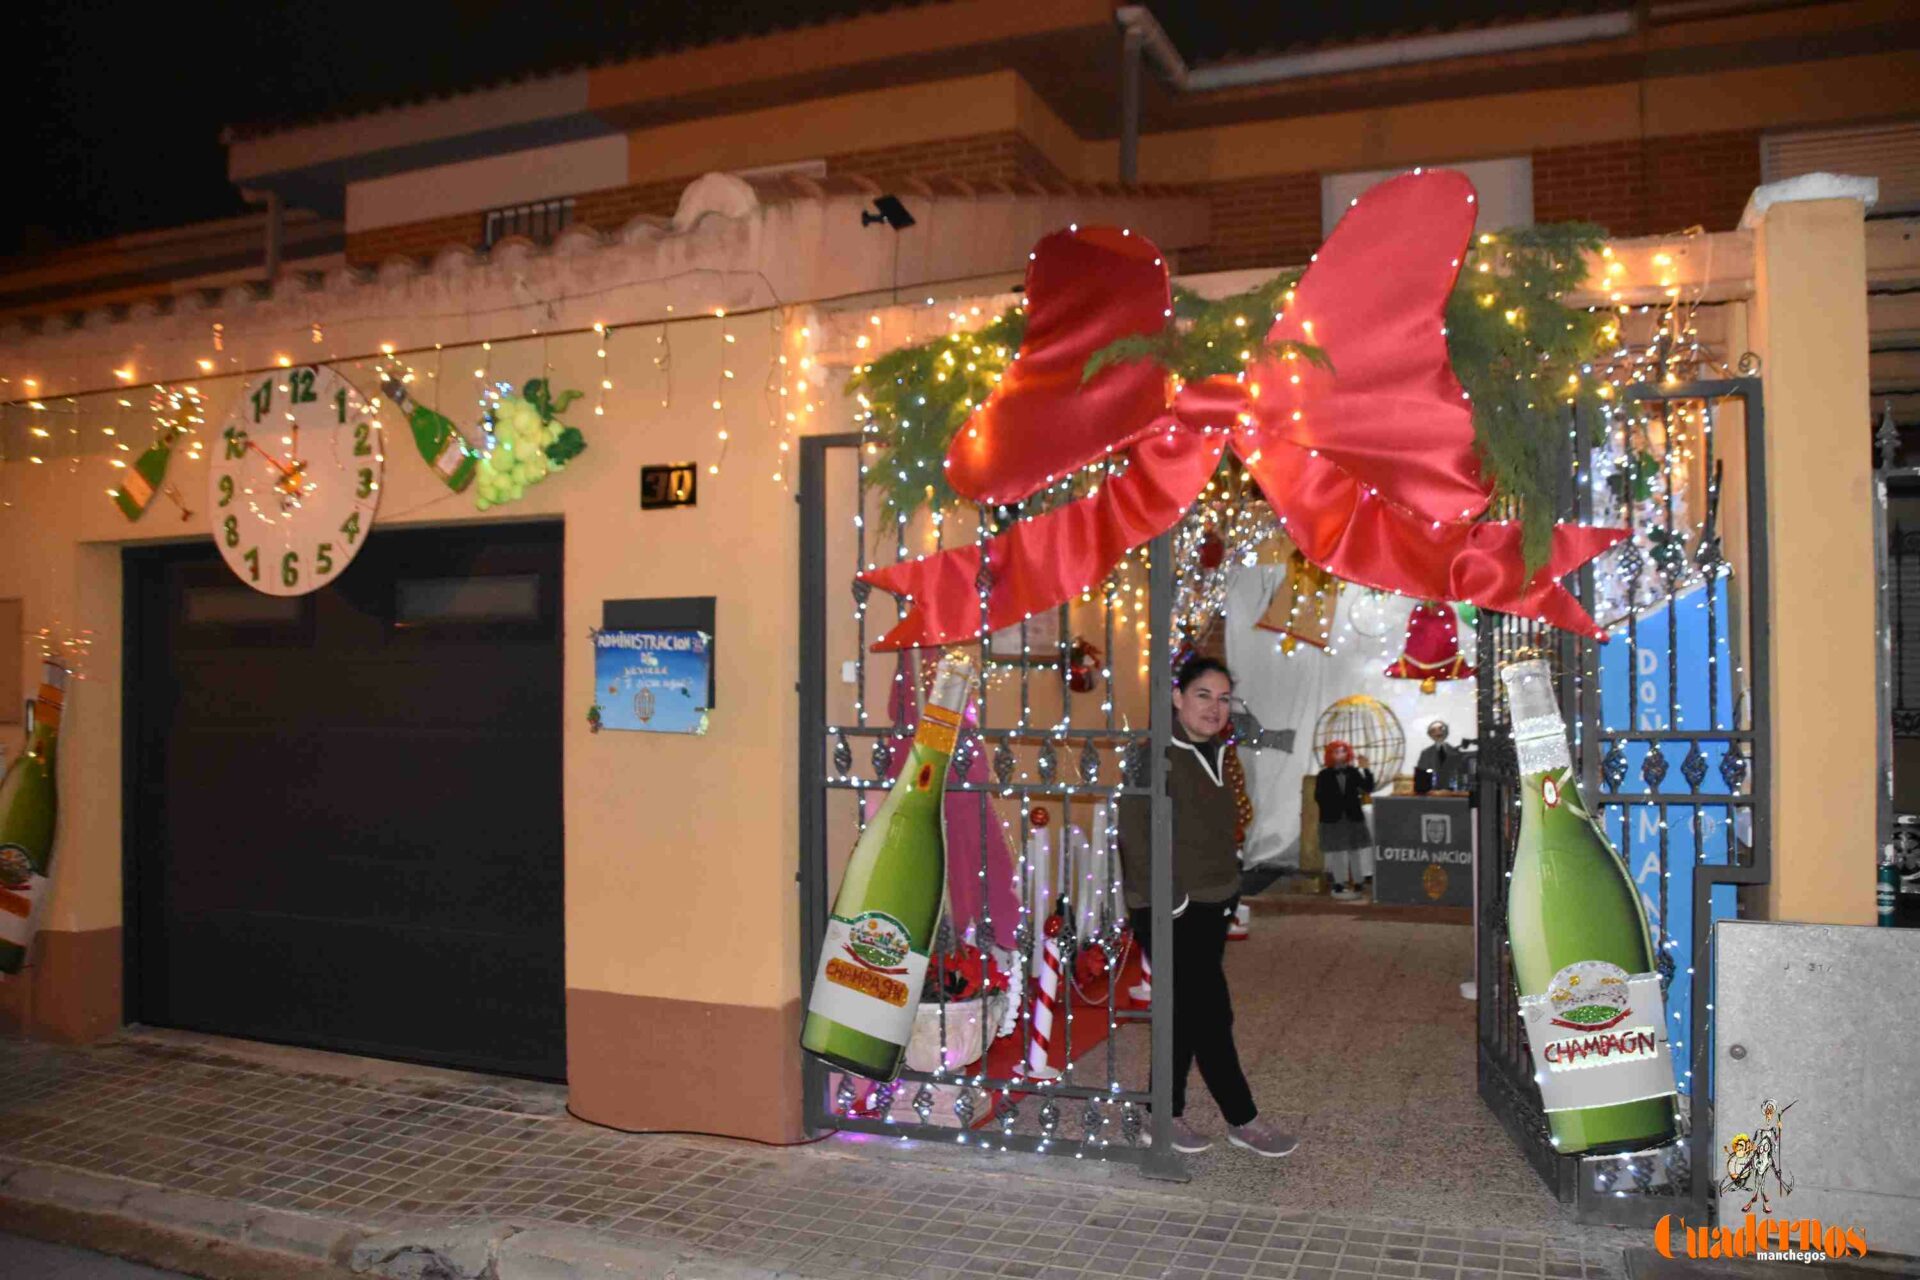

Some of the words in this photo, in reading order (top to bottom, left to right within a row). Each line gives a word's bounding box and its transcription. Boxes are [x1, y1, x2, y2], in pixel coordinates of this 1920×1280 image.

[288, 369, 317, 404] 12
[335, 387, 347, 424] 1
[353, 422, 372, 457] 2
[218, 474, 235, 508] 9
[356, 467, 374, 500] 3
[223, 514, 240, 549] 8
[339, 511, 361, 545] 4
[281, 550, 299, 588] 6
[315, 542, 333, 575] 5
[1543, 1030, 1656, 1065] CHAMPAGN
